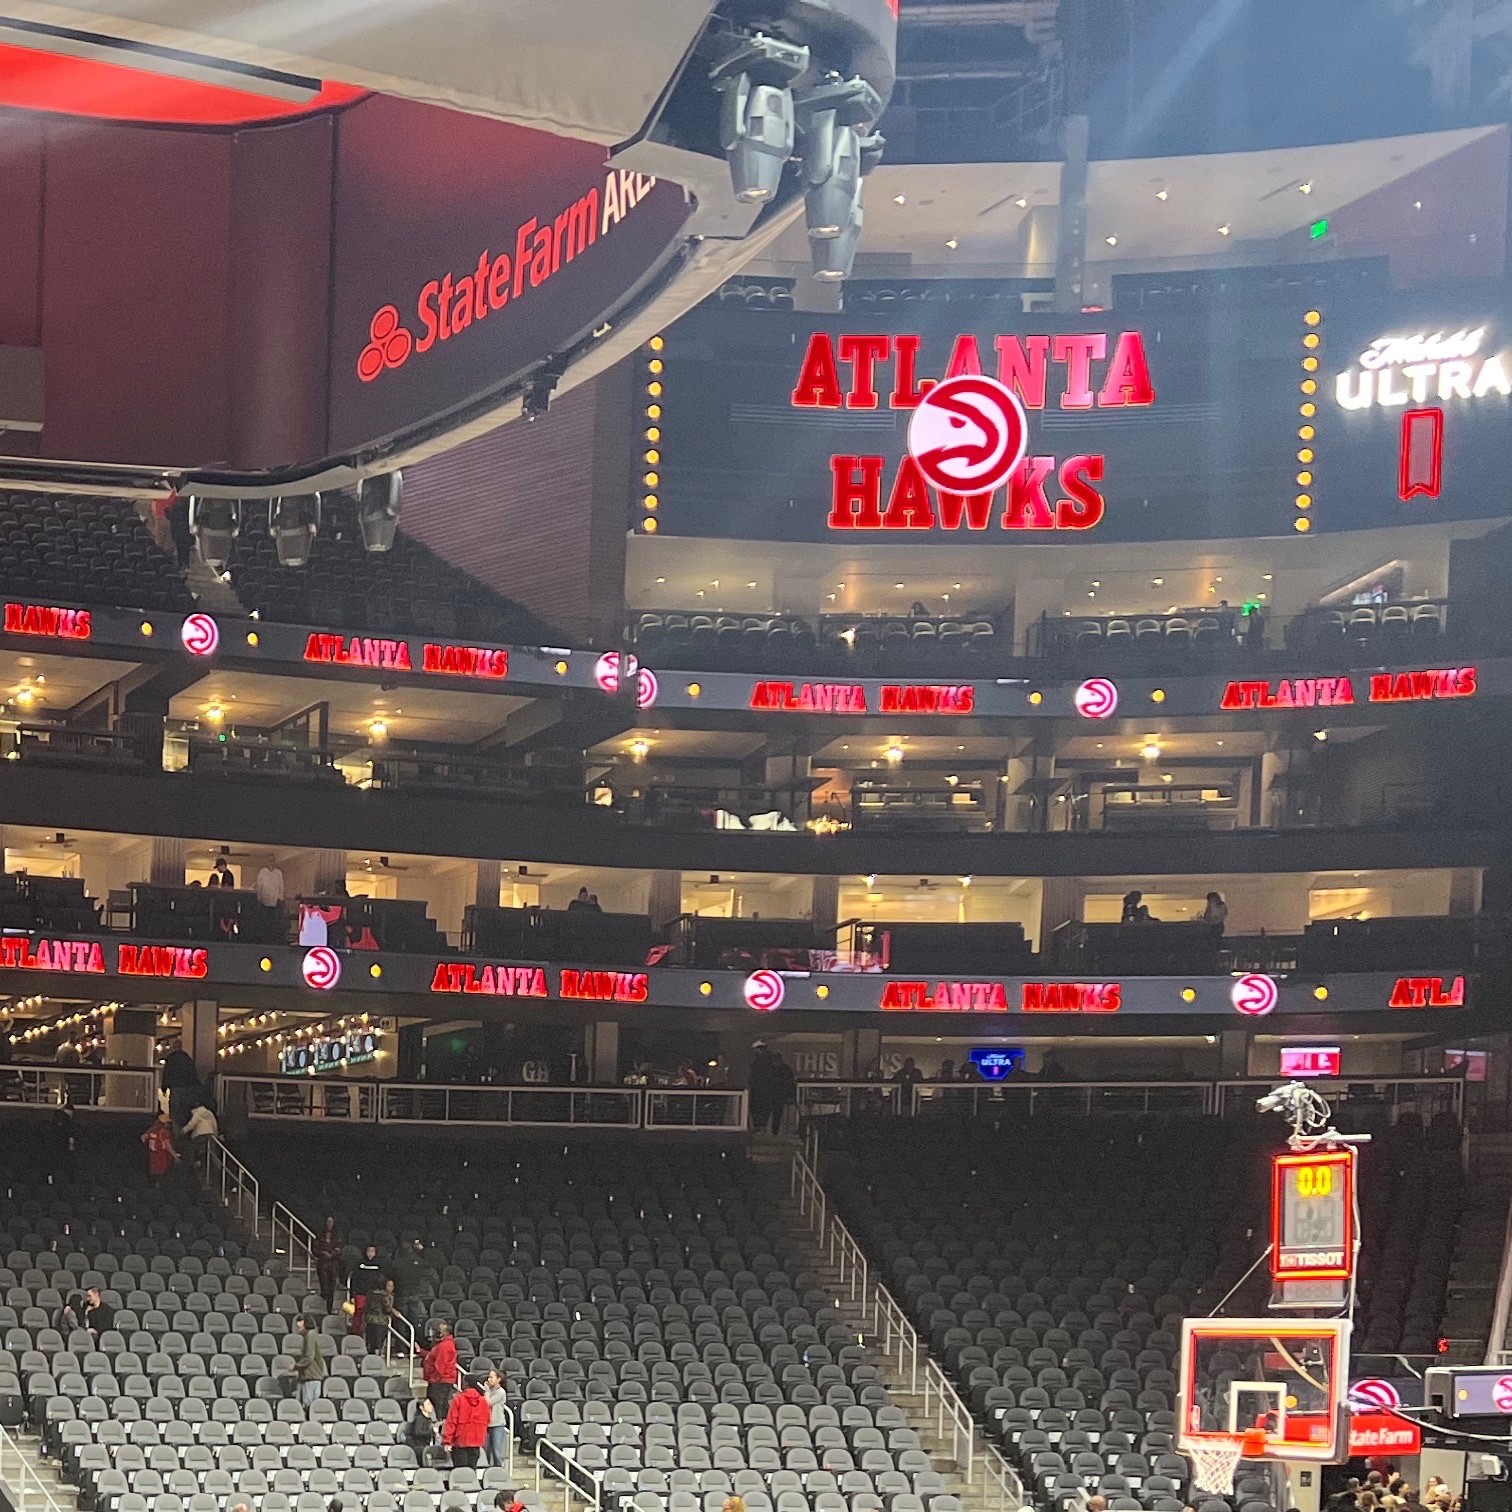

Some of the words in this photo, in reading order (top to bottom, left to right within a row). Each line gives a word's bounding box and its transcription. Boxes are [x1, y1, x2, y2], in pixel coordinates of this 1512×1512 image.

[791, 331, 1156, 409] ATLANTA
[1336, 355, 1511, 411] ULTRA
[827, 454, 1105, 530] HAWKS
[3, 603, 91, 640] HAWKS
[303, 633, 412, 671] ATLANTA
[422, 643, 508, 679] HAWKS
[749, 681, 867, 714] ATLANTA
[878, 685, 974, 716] HAWKS
[1220, 677, 1355, 710] ATLANTA
[1369, 667, 1477, 703] HAWKS
[117, 944, 208, 979] HAWKS
[431, 963, 548, 998] ATLANTA
[559, 970, 649, 1002] HAWKS
[879, 981, 1009, 1013] ATLANTA
[1021, 983, 1121, 1014] HAWKS
[1298, 1165, 1332, 1196] 0.0
[1297, 1252, 1345, 1266] TISSOT
